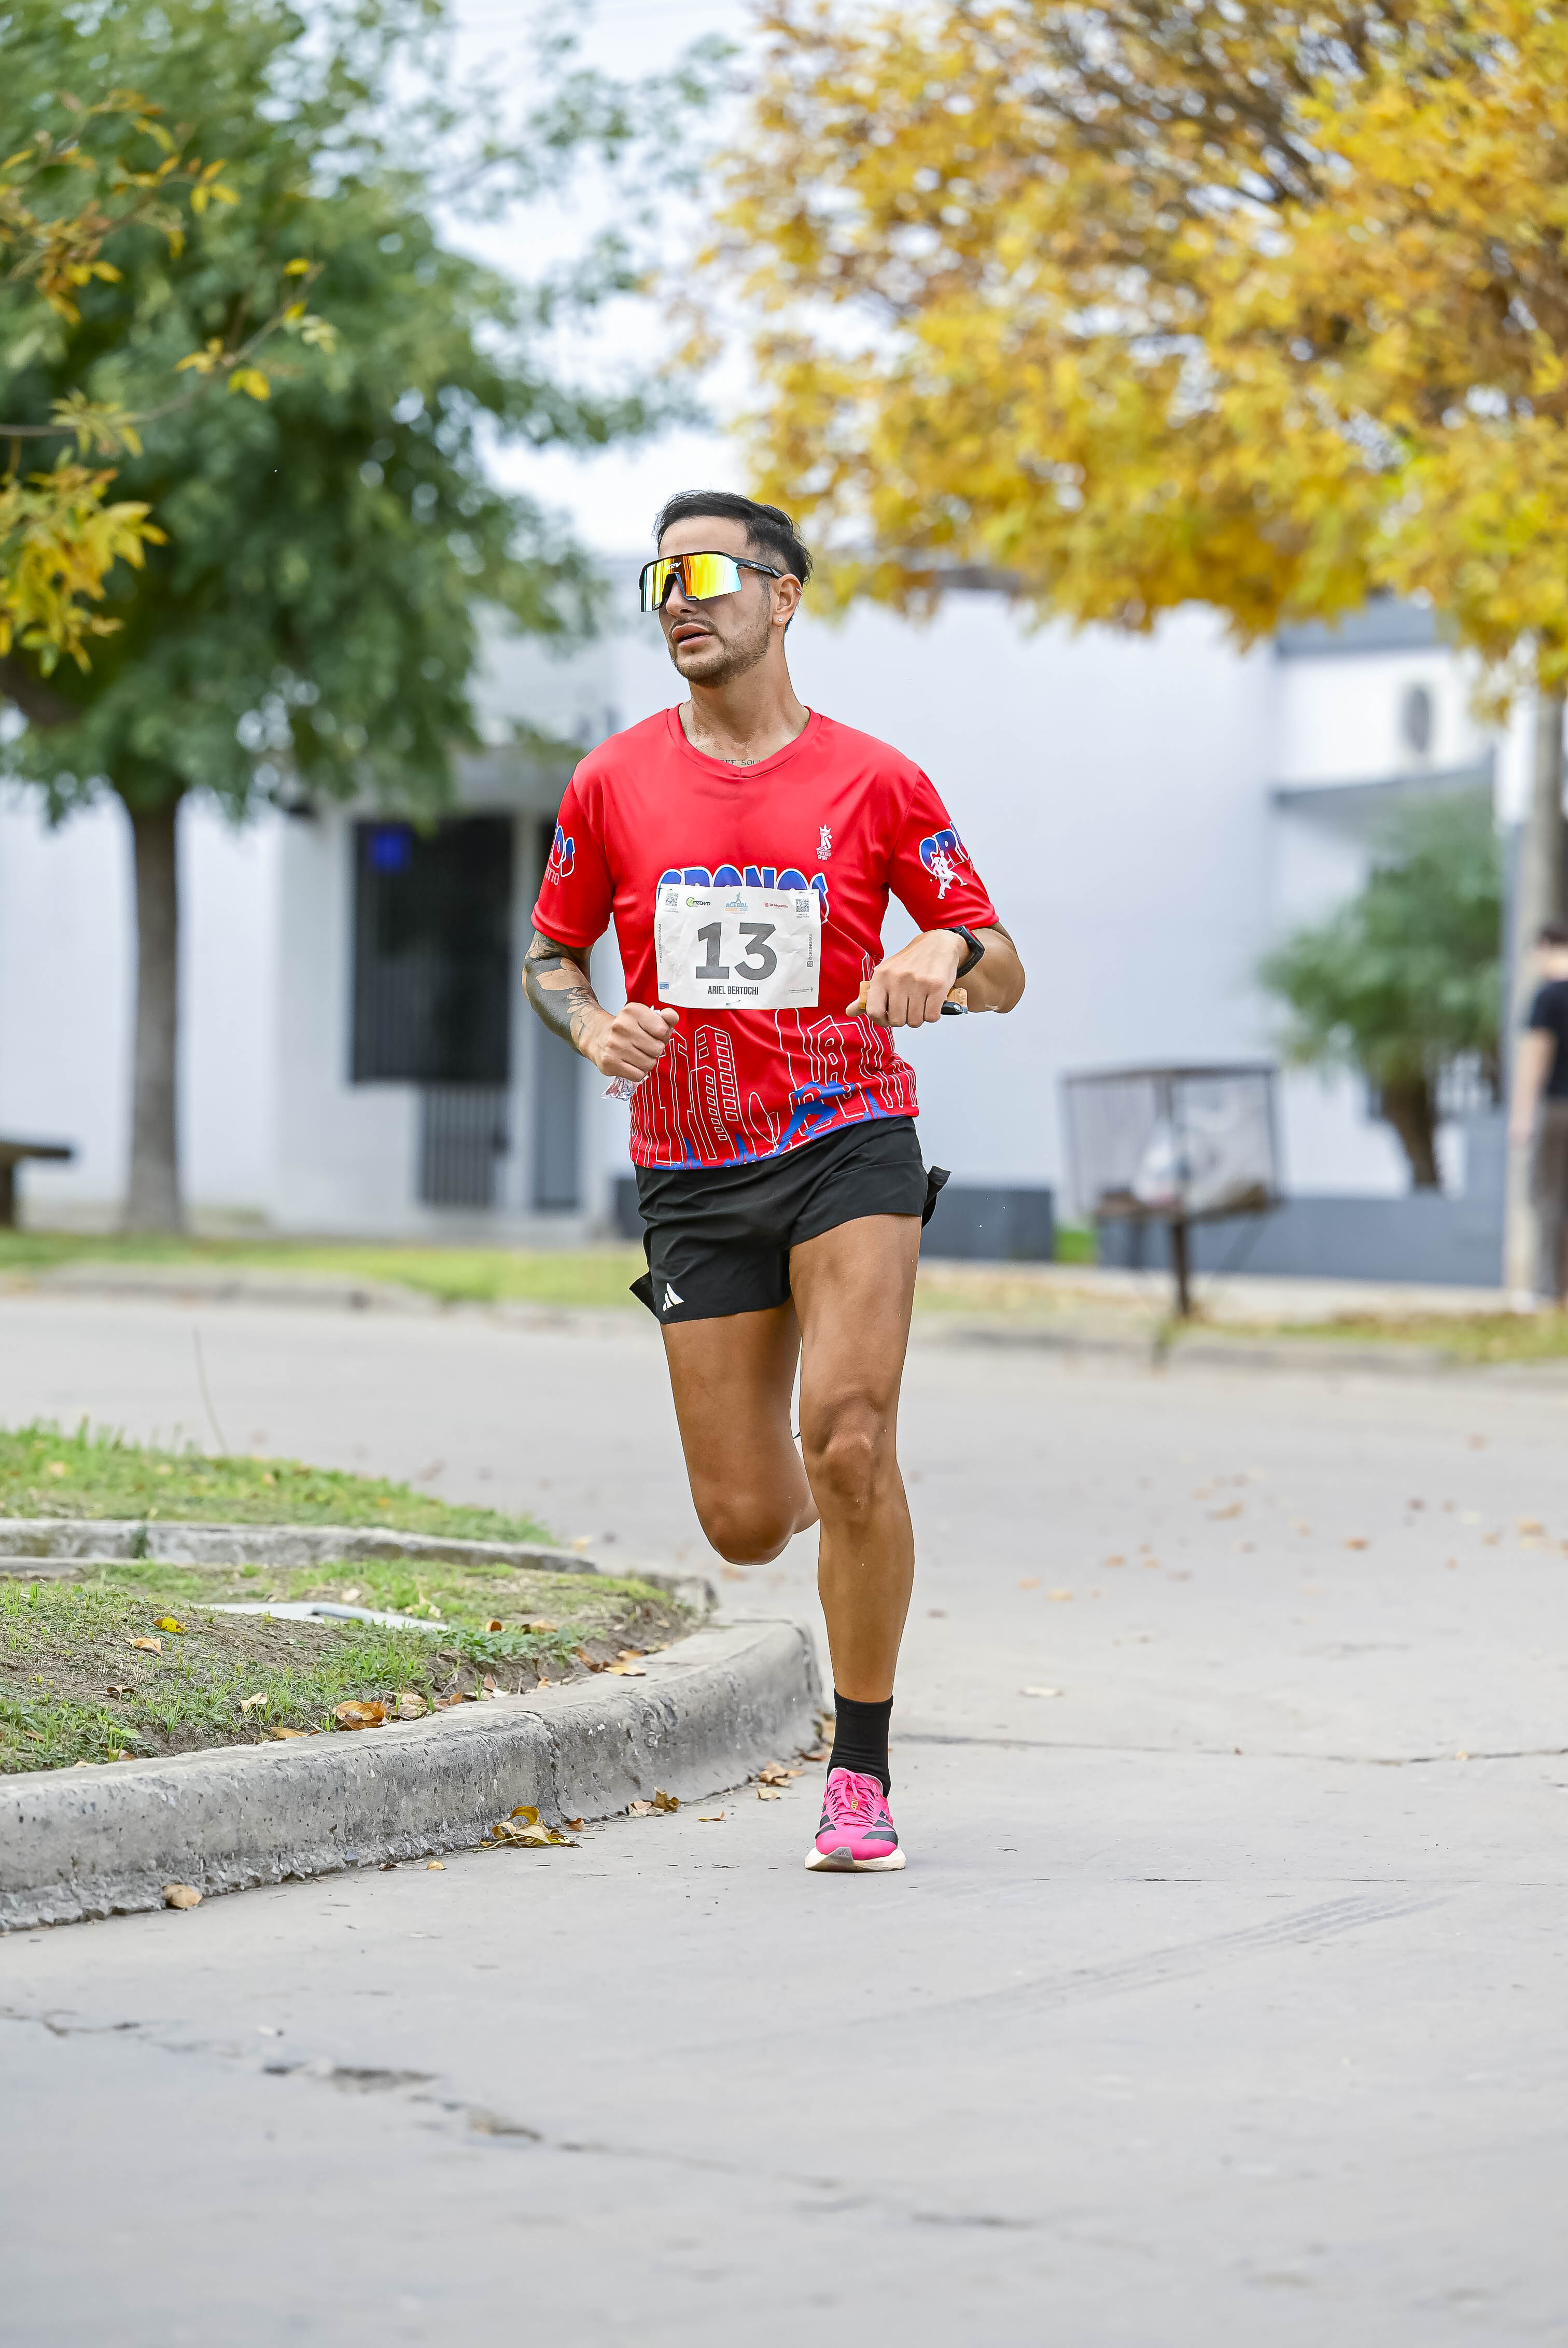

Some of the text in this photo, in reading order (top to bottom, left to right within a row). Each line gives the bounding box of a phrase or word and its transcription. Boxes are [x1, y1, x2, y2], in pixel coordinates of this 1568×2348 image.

[919, 821, 970, 877] CR
[696, 922, 777, 981] 13
[707, 986, 759, 995] ARIEL BERTOCHI
